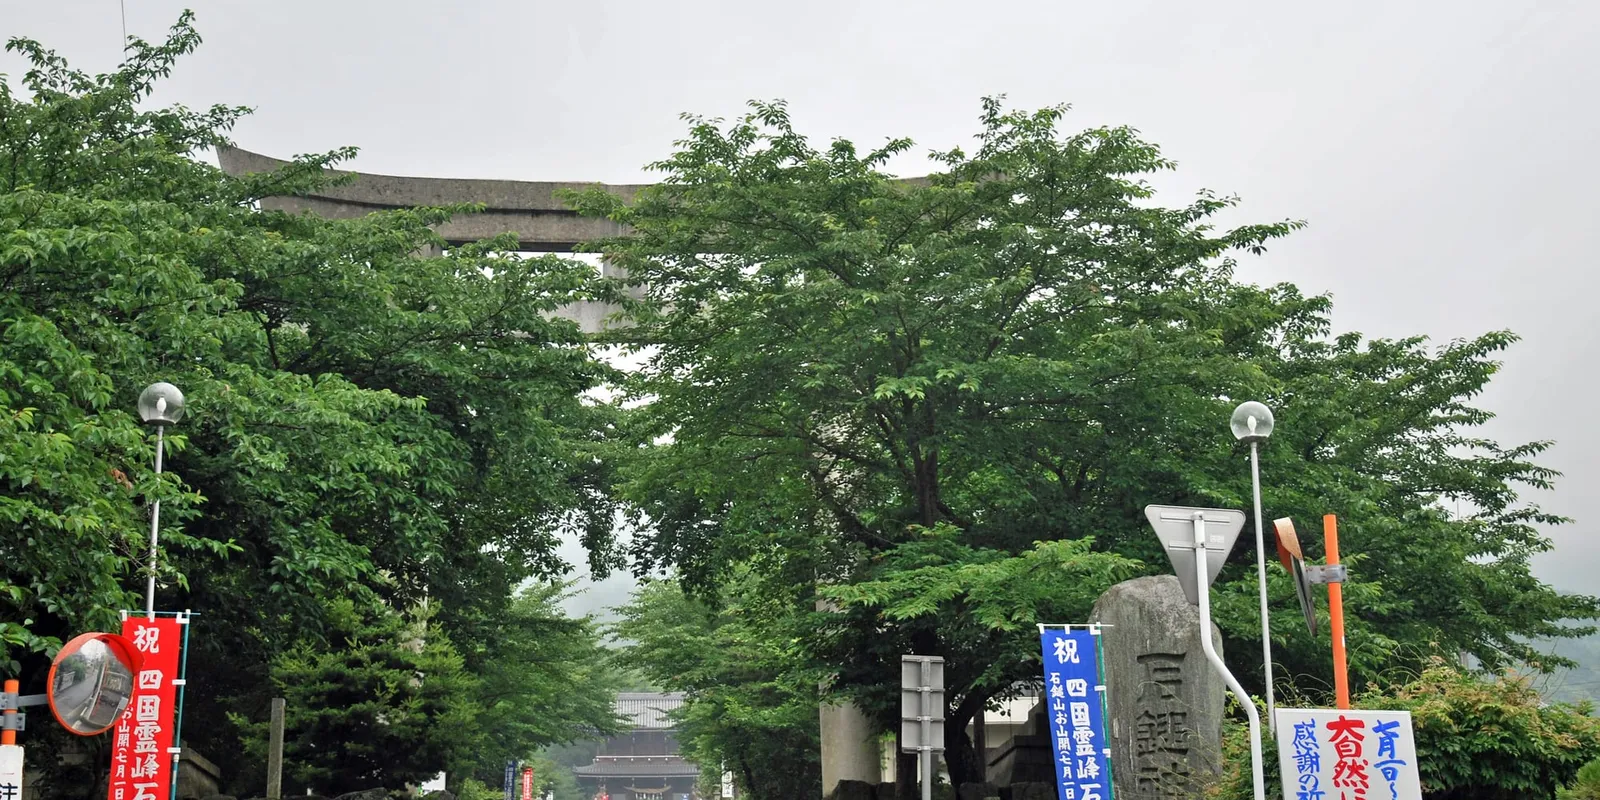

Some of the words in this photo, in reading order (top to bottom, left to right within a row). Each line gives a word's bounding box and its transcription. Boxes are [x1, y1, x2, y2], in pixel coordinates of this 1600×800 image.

[133, 625, 160, 654] 祝
[1053, 637, 1080, 664] 祝
[114, 697, 134, 800] お山開(七月一日
